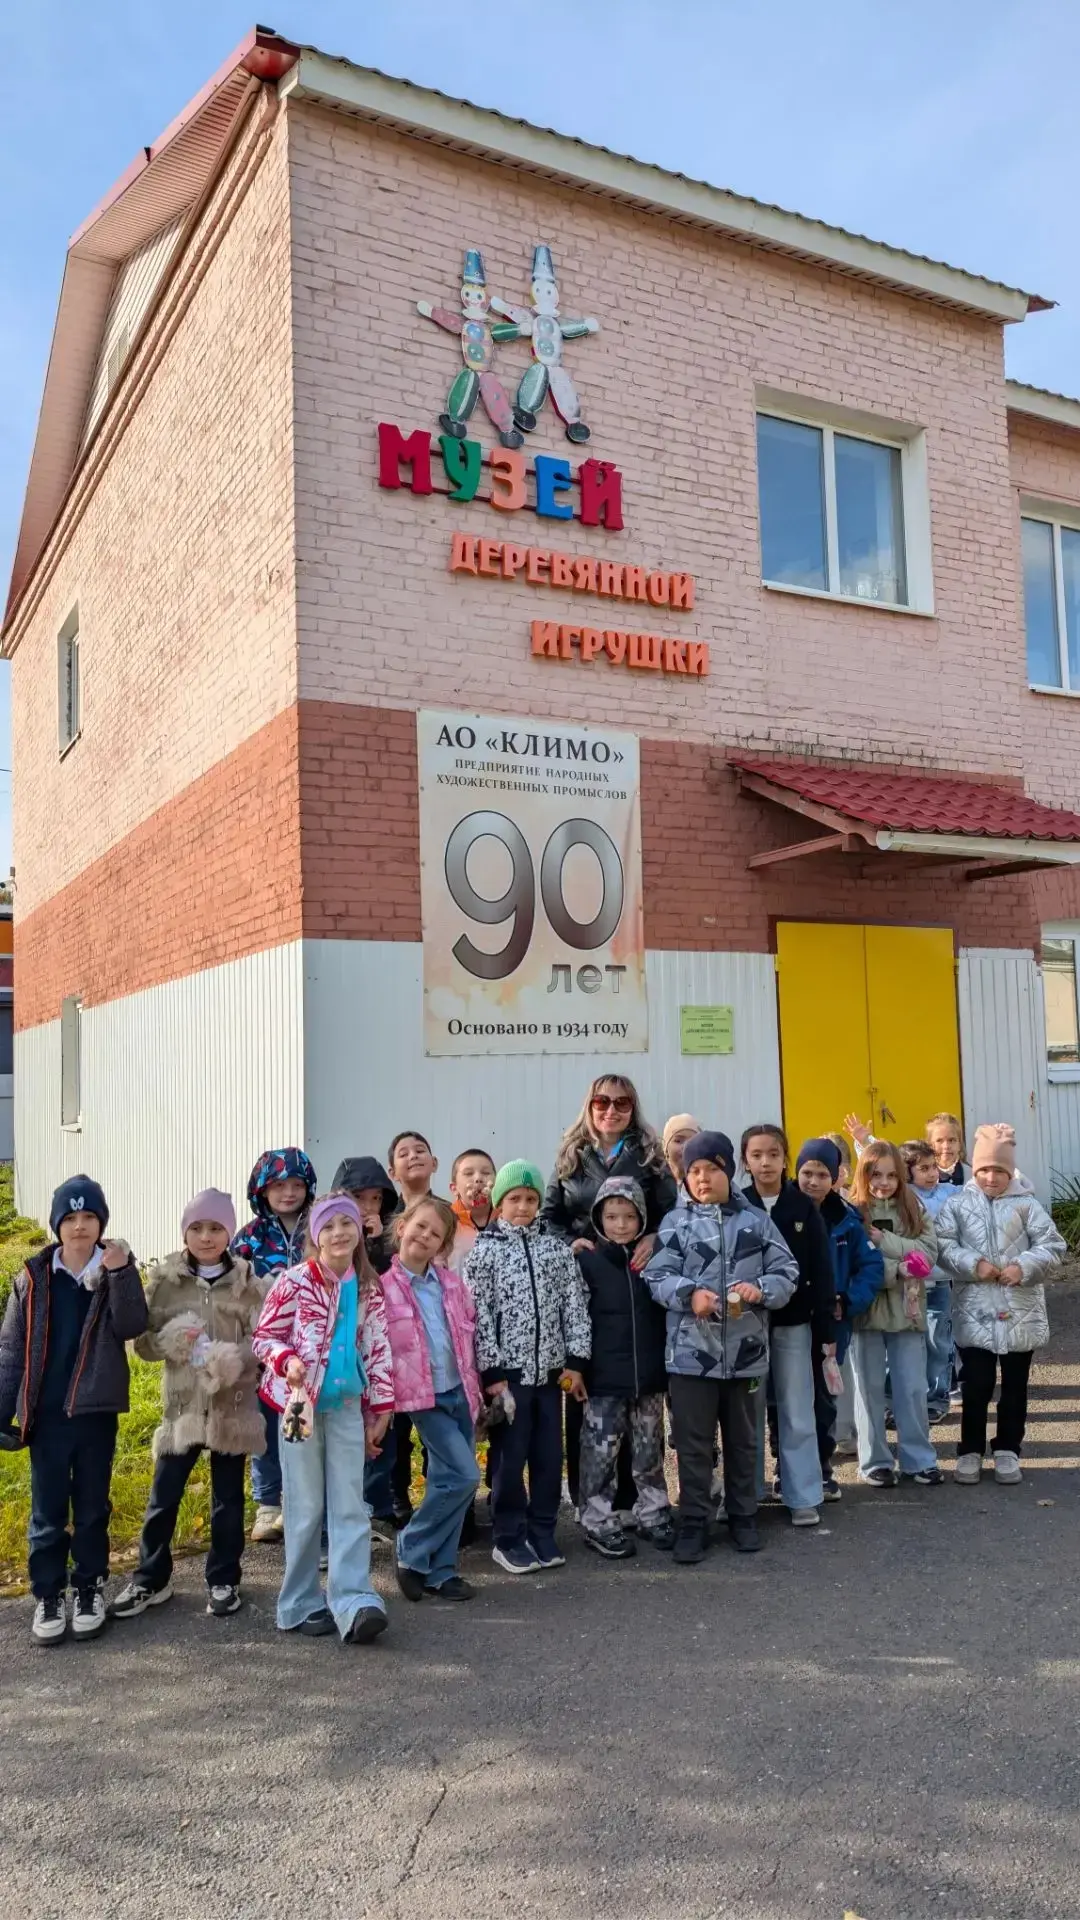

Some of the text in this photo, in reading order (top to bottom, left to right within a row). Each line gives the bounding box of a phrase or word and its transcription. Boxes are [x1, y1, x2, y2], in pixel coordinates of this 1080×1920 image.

[378, 422, 624, 531] МУЗЕЙ
[449, 532, 696, 611] ДЕРЕВЯННОЙ
[530, 619, 710, 676] ИГРУШКИ
[436, 724, 624, 763] АО «КЛИМО»
[436, 774, 627, 800] ХУДОЖЕСТВЕННЫХ ПРОМЫСЛОВ
[455, 758, 609, 783] ПРЕДПРИЯТИЕ НАРОДНЫХ
[444, 810, 624, 980] 90
[547, 964, 627, 993] лет
[447, 1019, 629, 1038] Основано в 1934 году
